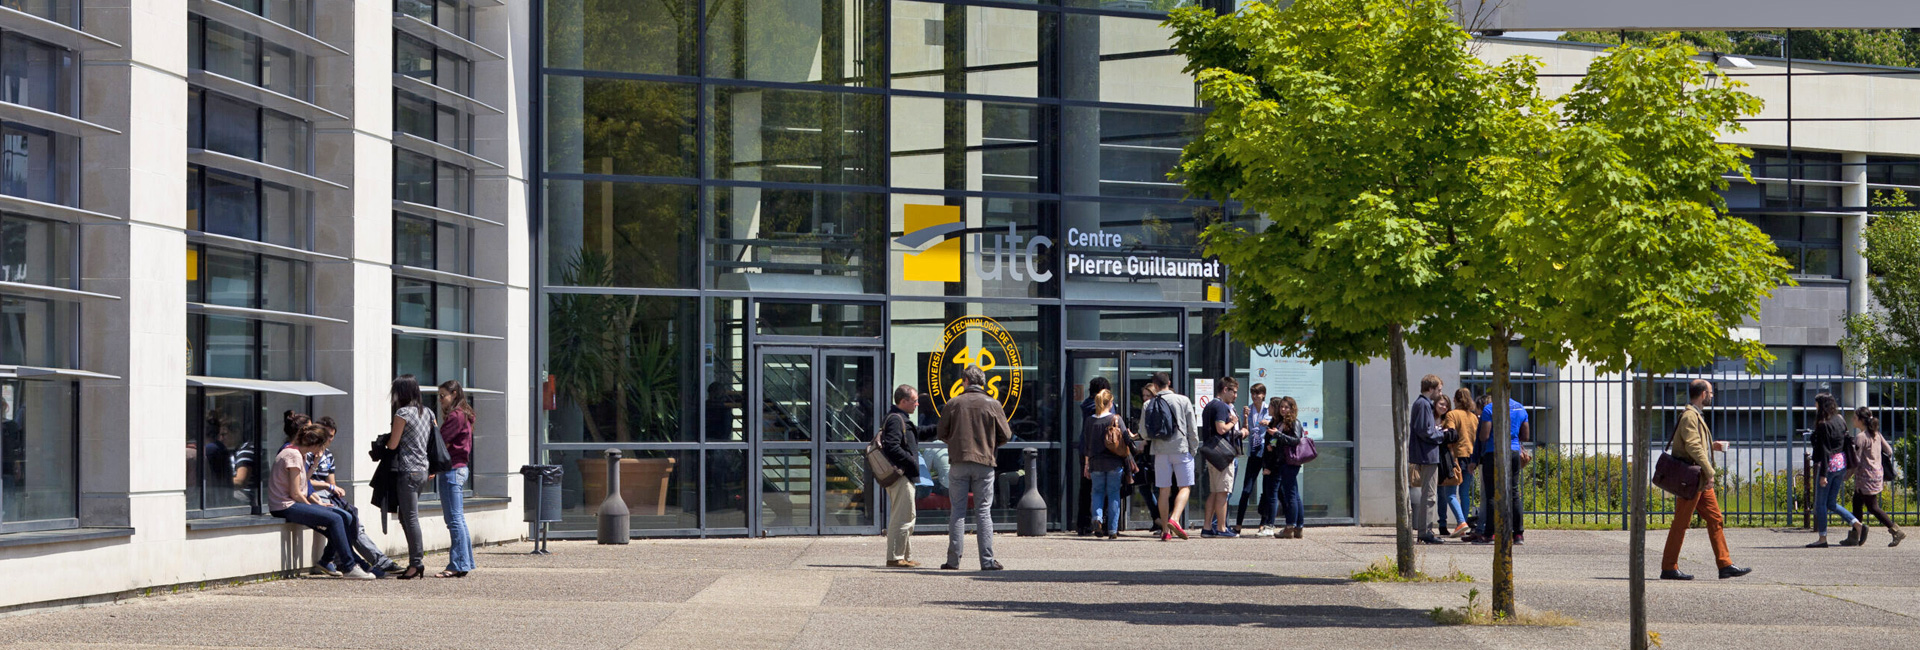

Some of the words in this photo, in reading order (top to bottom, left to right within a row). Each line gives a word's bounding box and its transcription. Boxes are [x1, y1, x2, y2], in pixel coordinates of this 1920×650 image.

[1068, 228, 1122, 248] Centre
[974, 221, 1053, 283] utc
[1068, 254, 1122, 275] Pierre
[1127, 256, 1220, 278] Guillaumat
[942, 330, 953, 344] DE
[951, 318, 1000, 335] TECHNOLOGIE
[998, 331, 1010, 345] DE
[952, 345, 996, 372] 40
